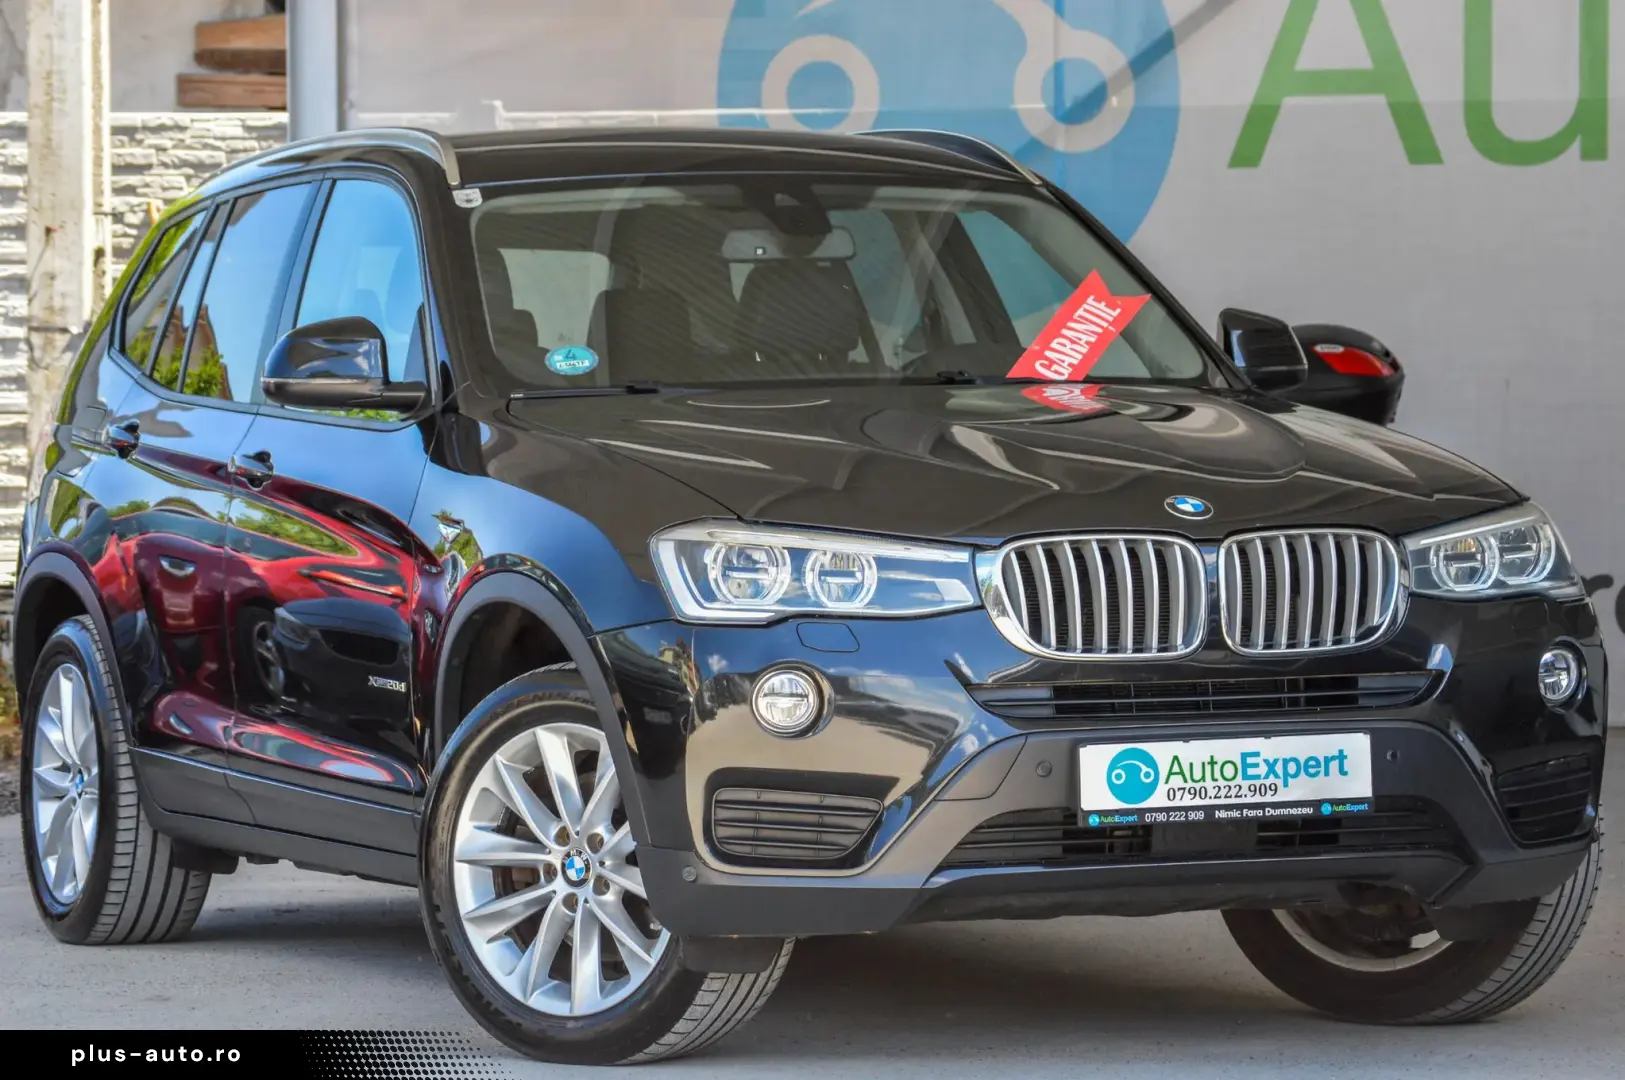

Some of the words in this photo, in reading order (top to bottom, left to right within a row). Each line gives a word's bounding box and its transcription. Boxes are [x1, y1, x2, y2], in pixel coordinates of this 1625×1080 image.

[1164, 749, 1348, 788] AutoExpert
[1167, 783, 1278, 801] 0790.222.909
[1215, 809, 1241, 819] Nimic
[1243, 808, 1263, 817] Fara
[1265, 806, 1313, 816] Dumnezeu
[1332, 803, 1369, 812] AutoExpert
[1100, 814, 1138, 824] AutoExpert
[1145, 812, 1167, 822] 0790
[1169, 811, 1186, 821] 222
[1188, 811, 1205, 820] 909
